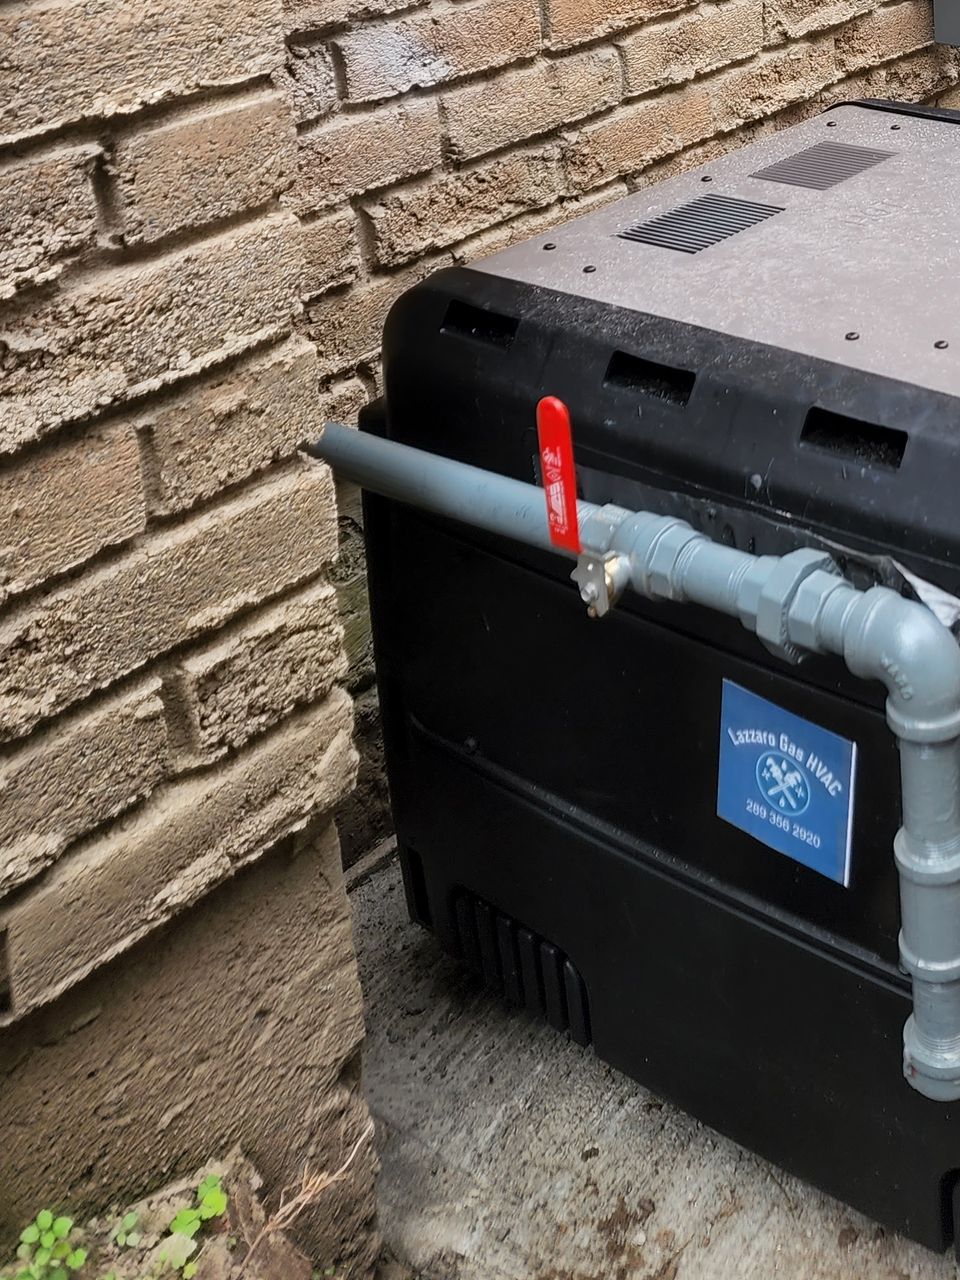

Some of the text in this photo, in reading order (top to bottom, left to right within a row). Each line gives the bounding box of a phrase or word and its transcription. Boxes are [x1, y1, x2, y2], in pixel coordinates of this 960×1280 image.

[727, 726, 842, 796] Lazzaro Gas HVAC
[746, 798, 767, 820] 289
[791, 823, 820, 849] 2920
